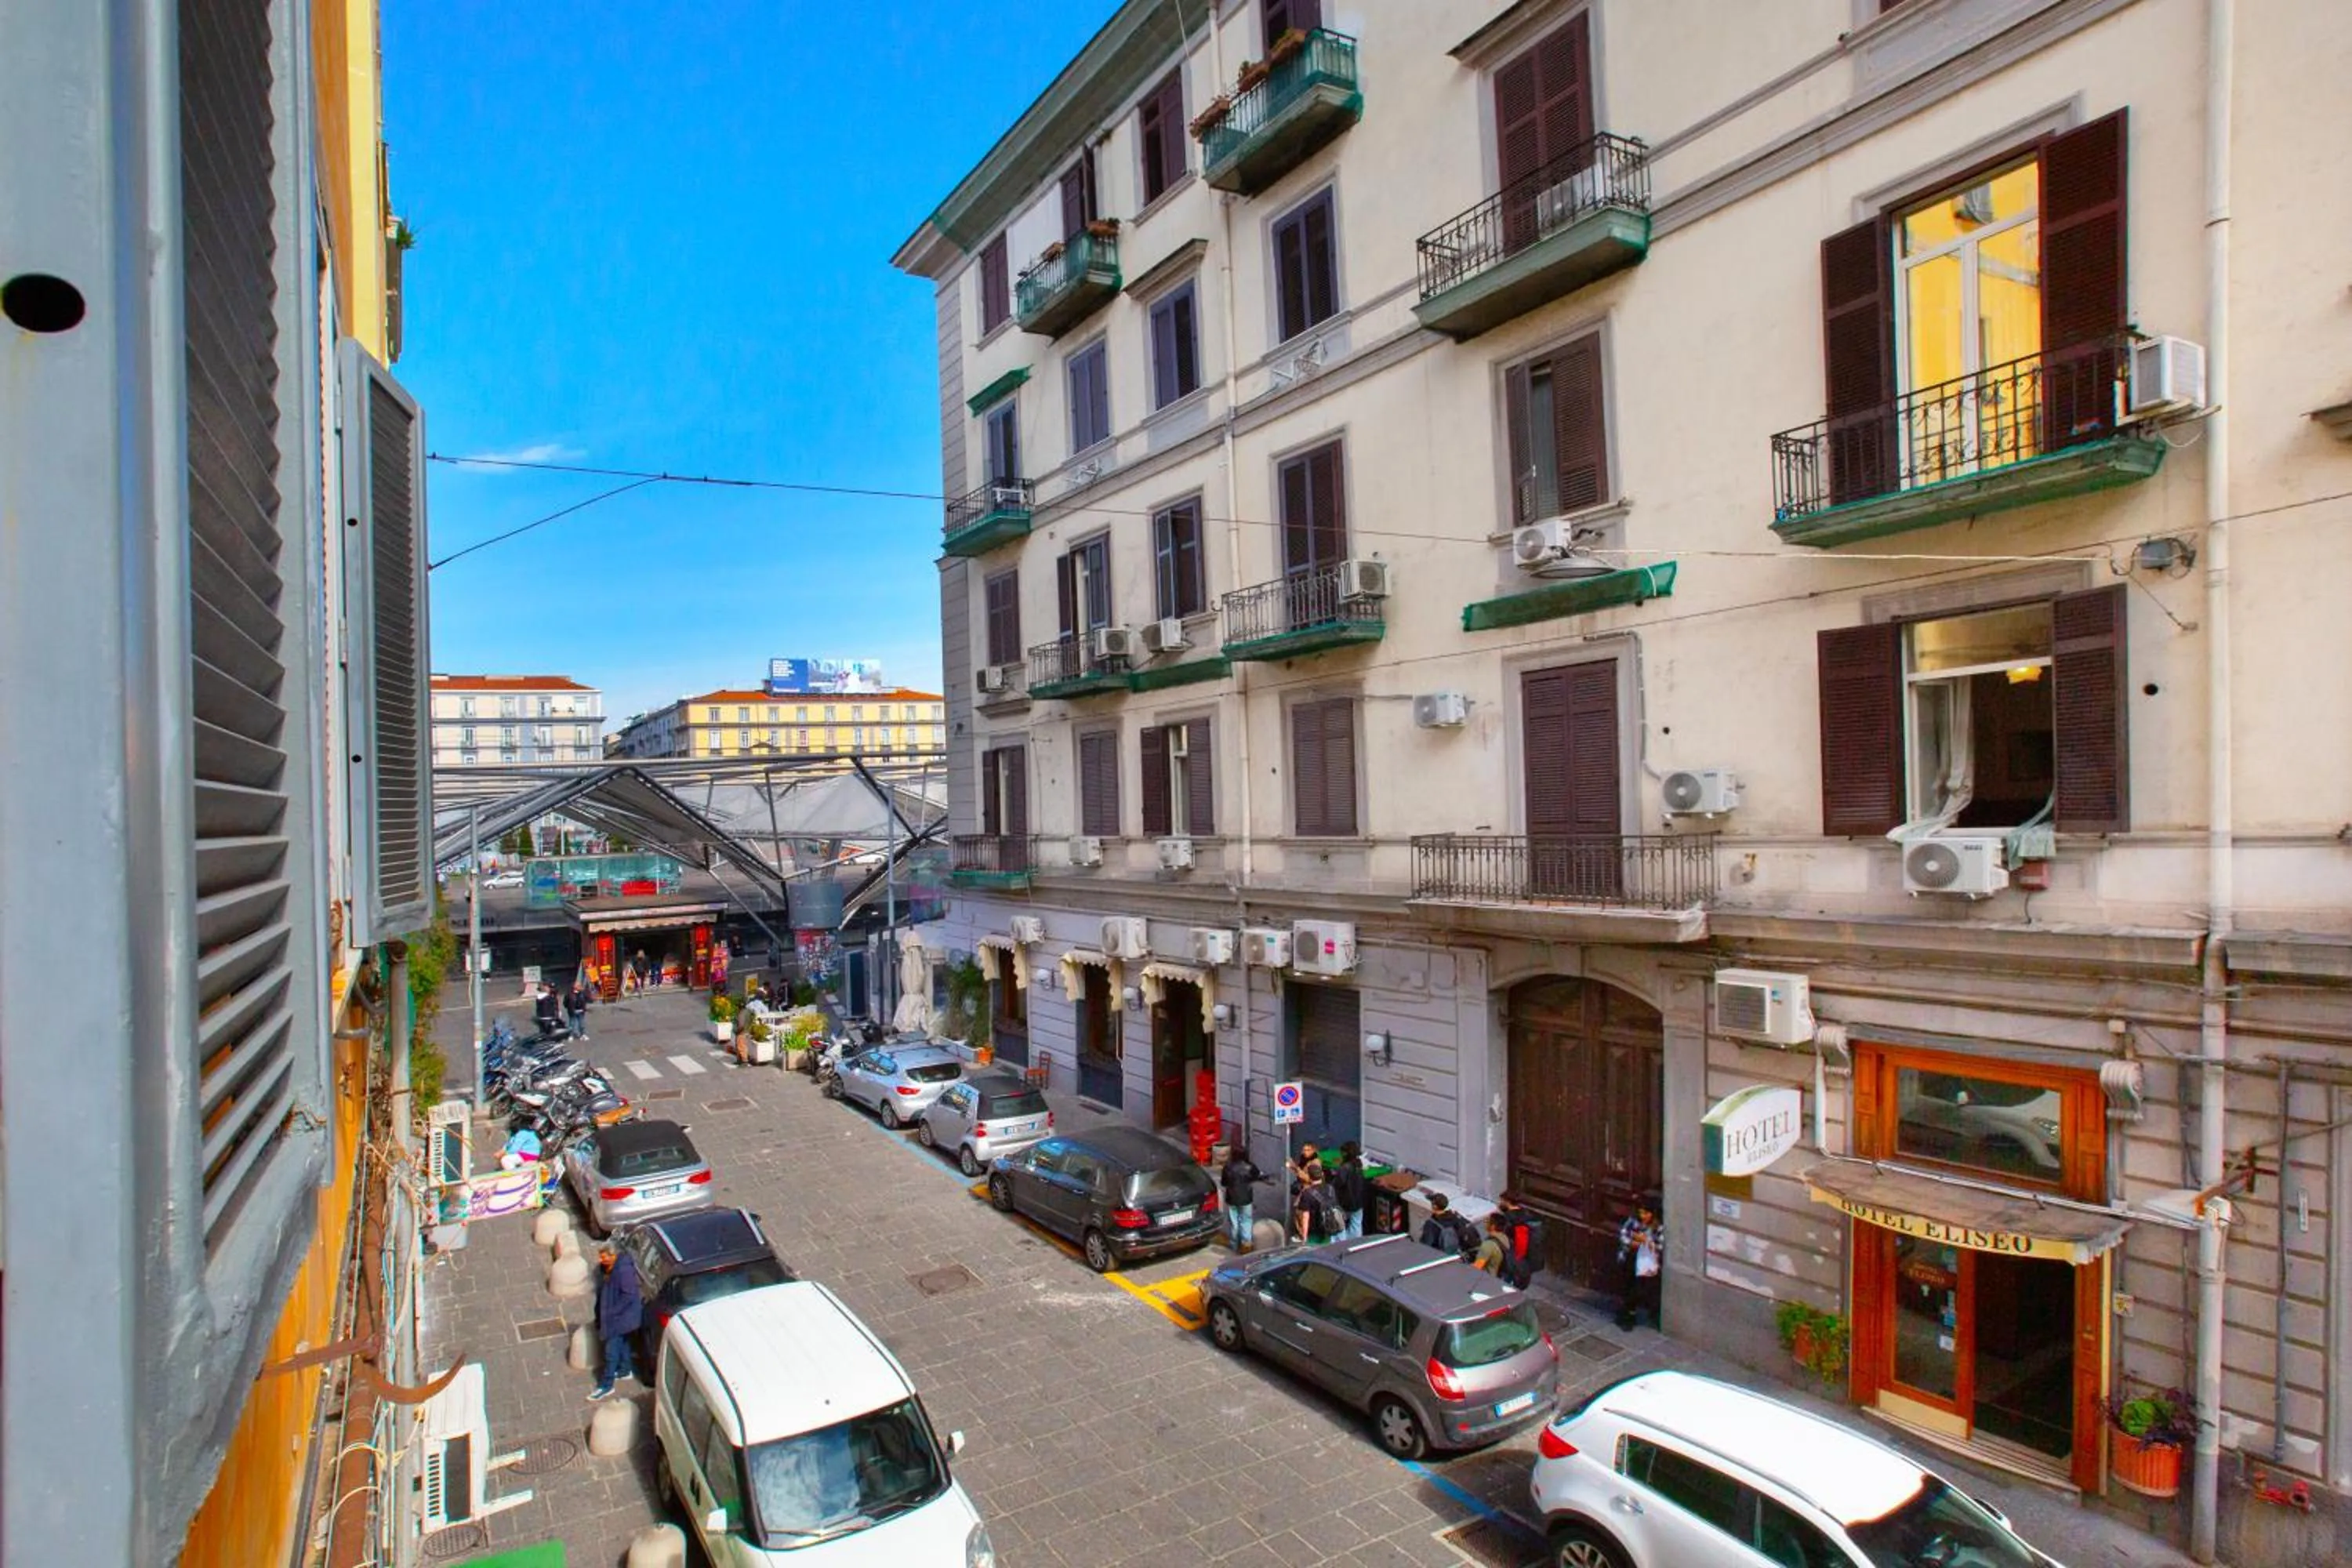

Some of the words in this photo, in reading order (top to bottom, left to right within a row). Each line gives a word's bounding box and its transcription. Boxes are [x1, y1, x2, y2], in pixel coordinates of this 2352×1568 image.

[1727, 1110, 1796, 1159] HOTEL
[1841, 1199, 1912, 1231] HOTEL
[1926, 1222, 2032, 1254] ELISEO
